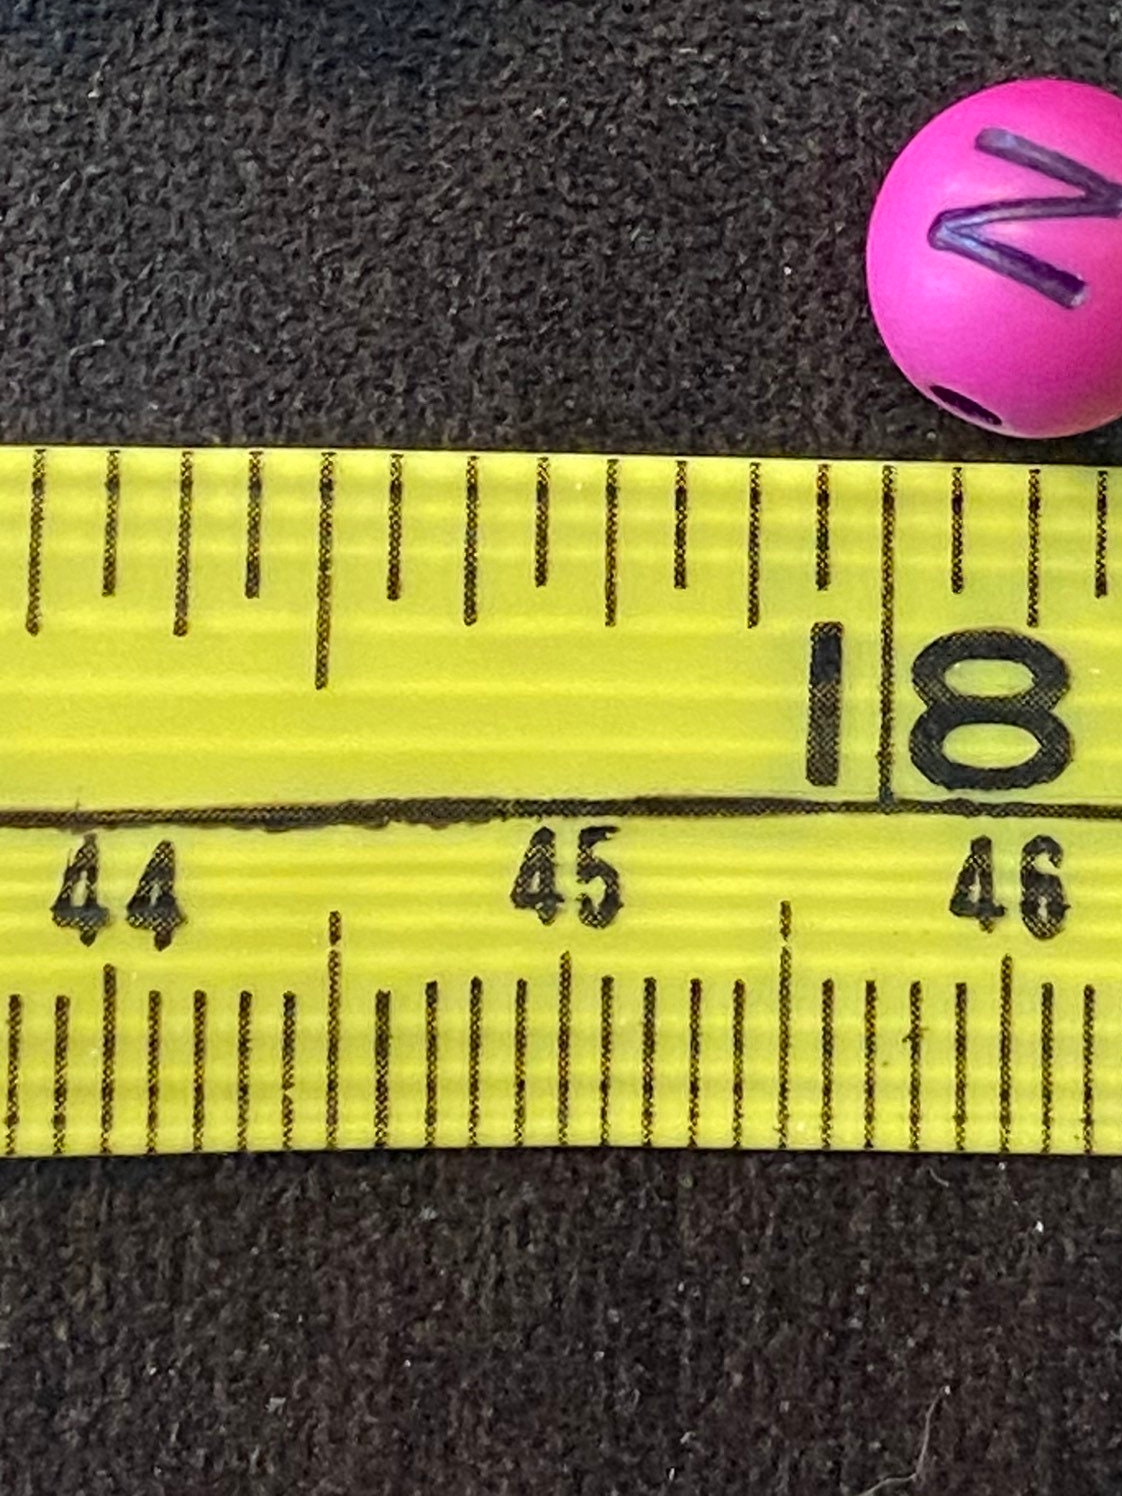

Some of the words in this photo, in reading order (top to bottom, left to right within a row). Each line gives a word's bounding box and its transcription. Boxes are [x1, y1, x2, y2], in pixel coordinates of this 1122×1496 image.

[51, 834, 188, 951] 44
[510, 826, 622, 928] 45
[949, 836, 1070, 939] 46
